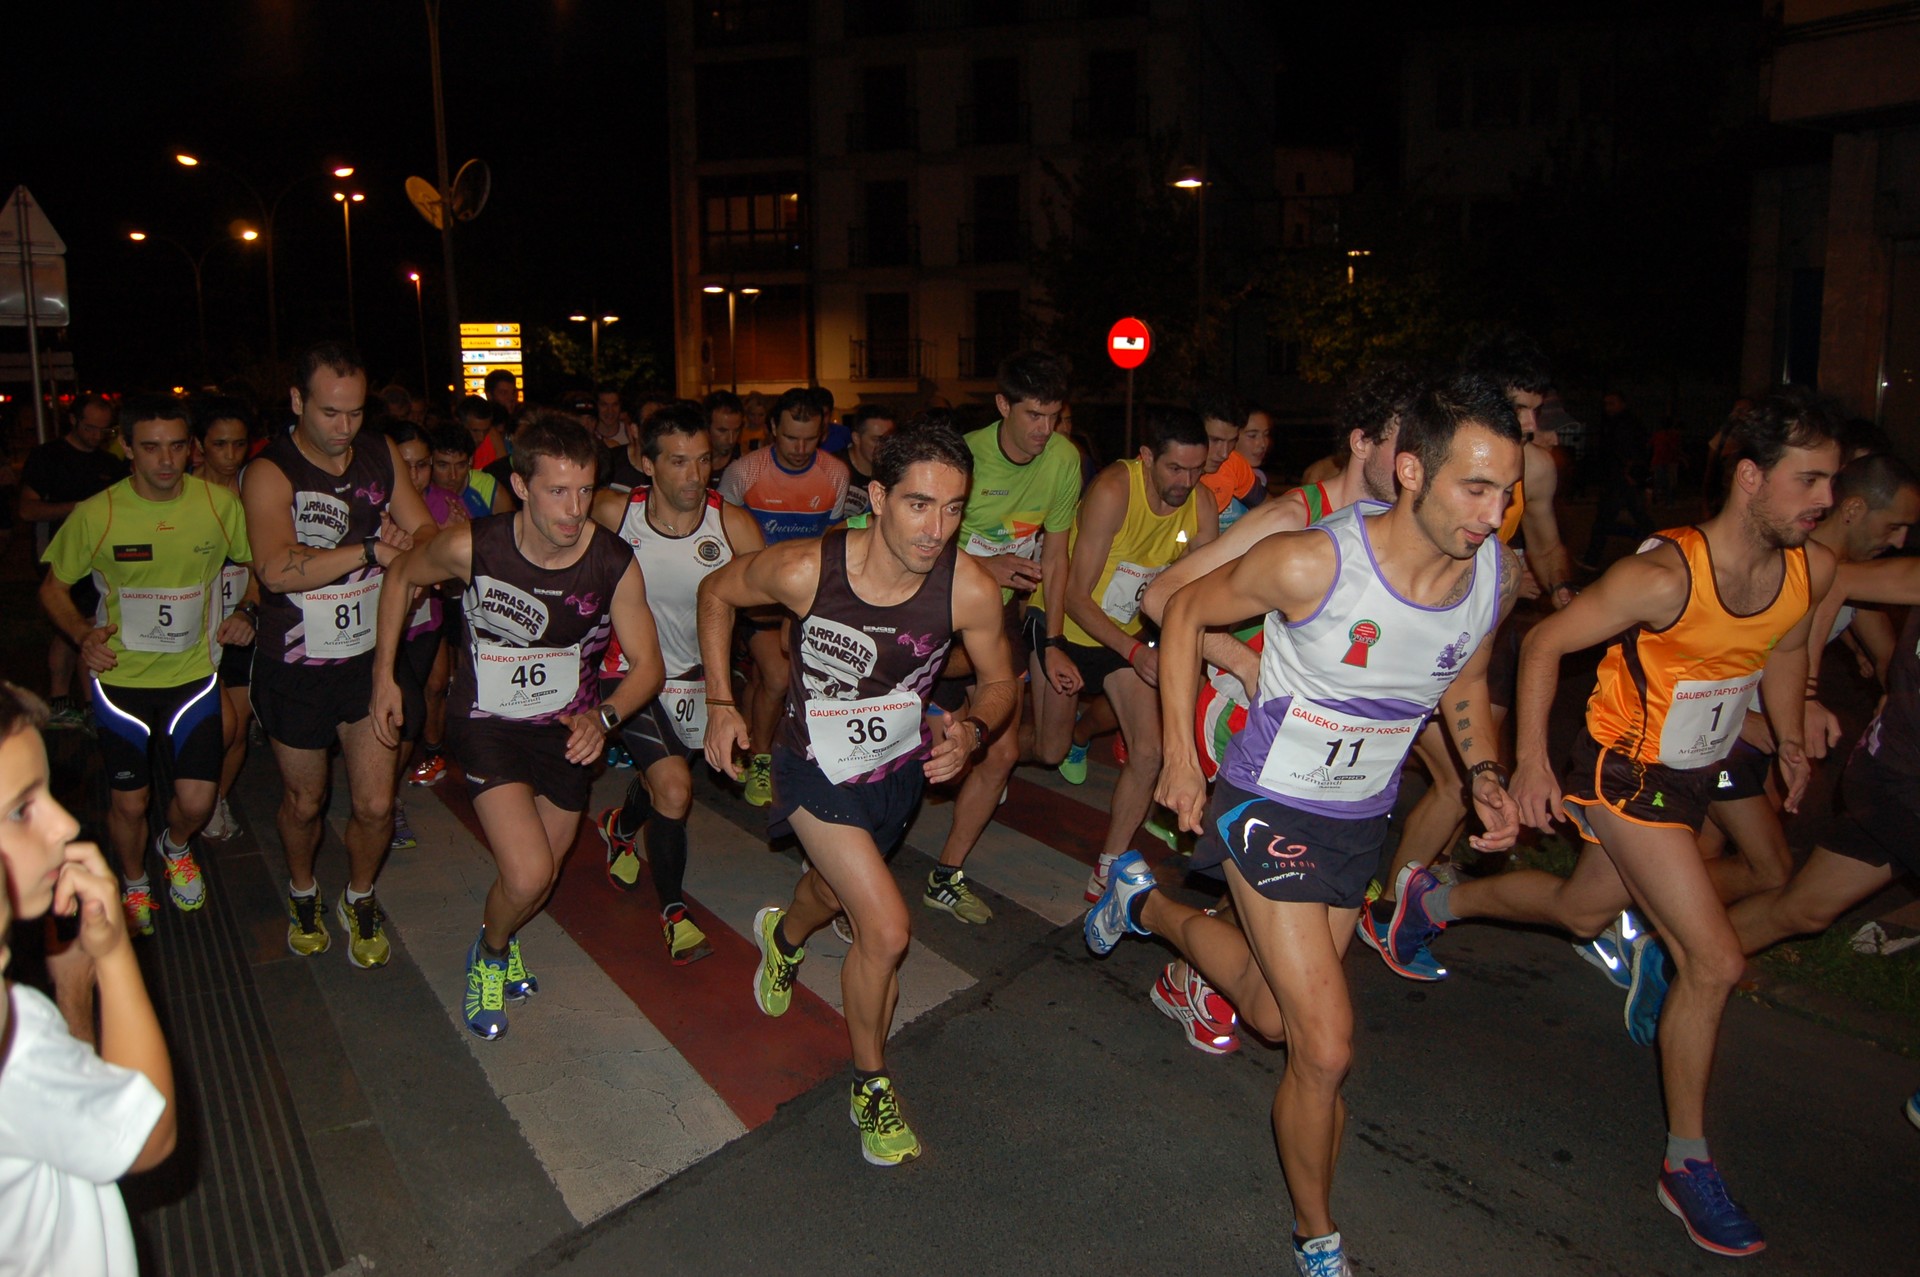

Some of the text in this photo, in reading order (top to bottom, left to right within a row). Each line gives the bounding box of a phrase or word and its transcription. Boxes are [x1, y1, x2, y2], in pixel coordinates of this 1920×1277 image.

[299, 514, 347, 535] RUNNERS
[304, 501, 349, 525] ARRASATE
[155, 593, 178, 601] TAFYD
[180, 591, 201, 600] KROSA
[340, 590, 361, 599] TAFYD
[362, 583, 379, 594] KROSA
[158, 604, 173, 627] 5
[335, 601, 361, 630] 81
[482, 601, 539, 635] RUNNERS
[485, 588, 545, 625] ARRASATE
[807, 637, 867, 674] RUNNERS
[809, 626, 873, 662] ARRASATE
[481, 653, 515, 662] GAUEKO
[517, 653, 543, 661] TAFYD
[511, 663, 546, 688] 46
[1676, 690, 1711, 700] GAUEKO
[1713, 687, 1738, 696] TAFYD
[675, 699, 695, 722] 90
[810, 701, 915, 717] GAUEKO TAFYD KROSA
[1292, 707, 1411, 735] GAUEKO TAFYD KROSA
[1711, 702, 1723, 732] 1
[846, 716, 887, 744] 36
[1325, 738, 1365, 767] 11
[1290, 771, 1342, 786] Arizmendi
